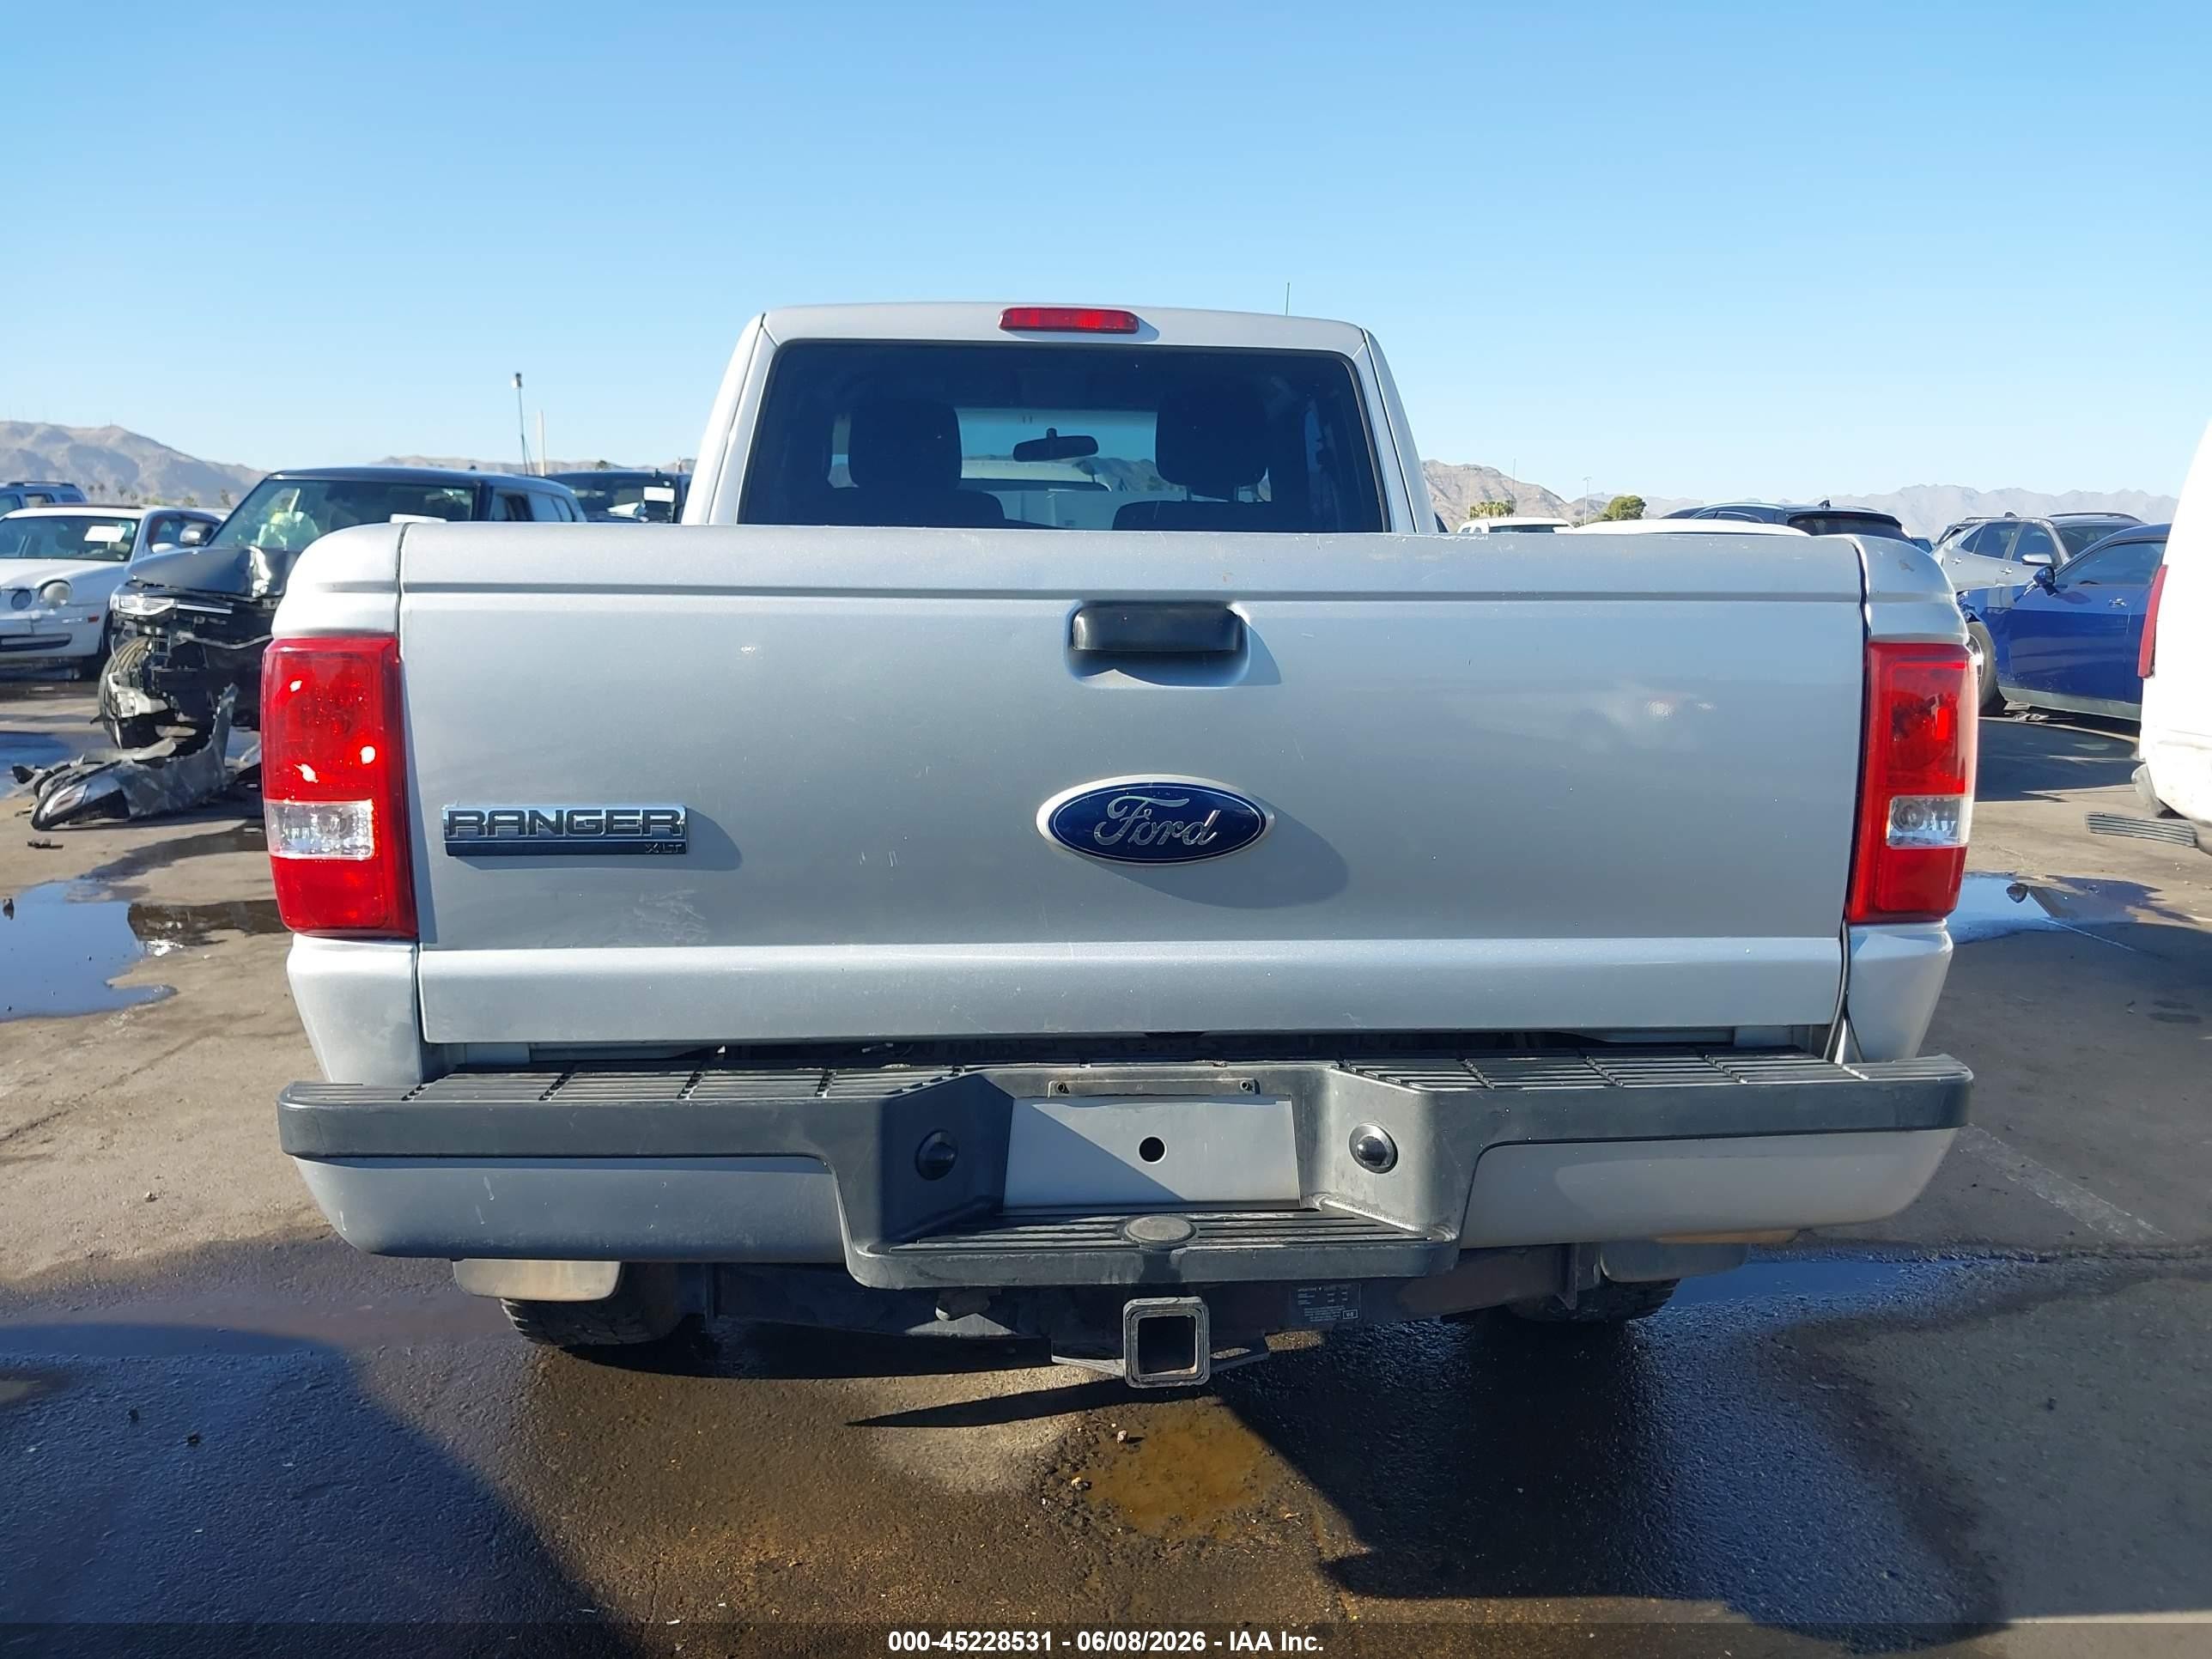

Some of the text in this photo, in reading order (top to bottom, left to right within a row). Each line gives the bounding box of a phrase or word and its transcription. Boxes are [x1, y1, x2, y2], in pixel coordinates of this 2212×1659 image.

[447, 809, 683, 837] RANGER
[1093, 795, 1221, 846] Ford
[645, 842, 683, 854] XLT
